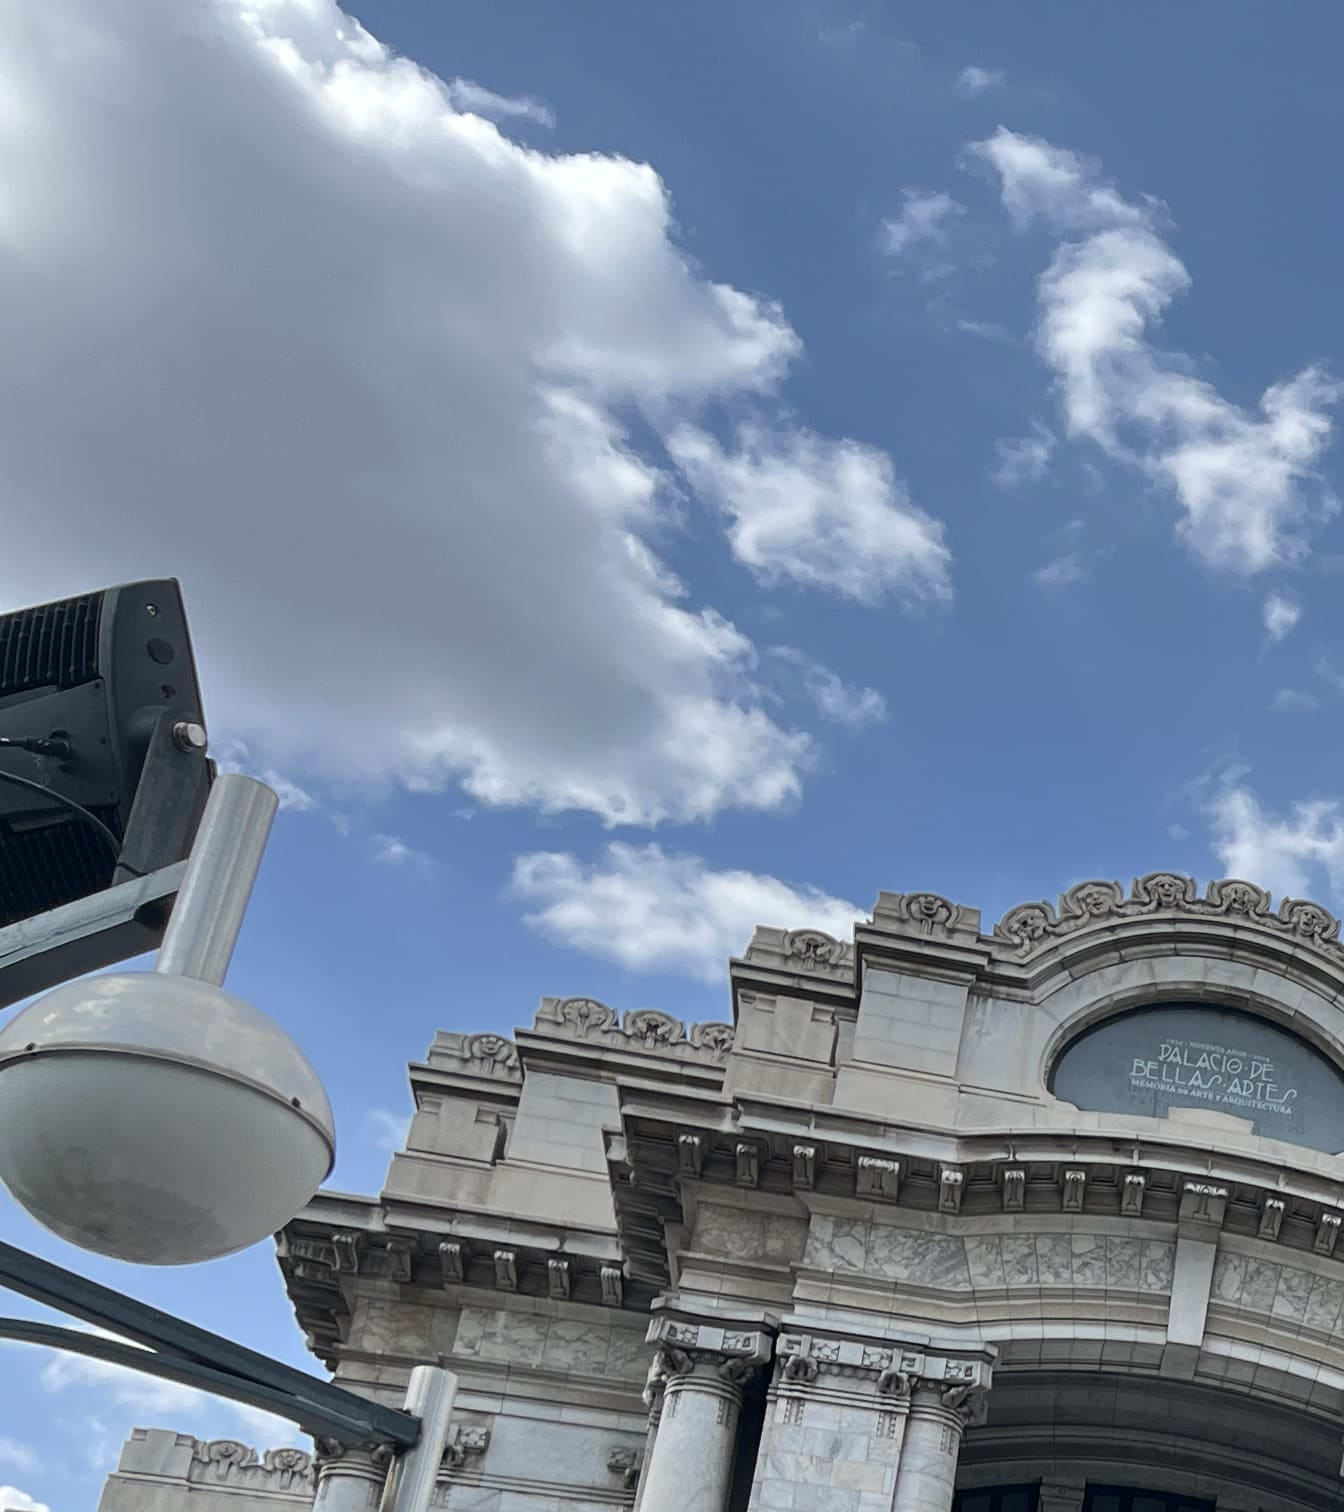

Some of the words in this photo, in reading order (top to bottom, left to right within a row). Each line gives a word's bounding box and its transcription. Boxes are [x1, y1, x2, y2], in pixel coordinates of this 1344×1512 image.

[1129, 1058, 1222, 1089] BELLAS
[1226, 1077, 1298, 1103] ARTES
[1158, 1044, 1243, 1075] PALACIO
[1249, 1061, 1275, 1082] DE
[1131, 1077, 1176, 1093] MEMORIA
[1190, 1089, 1214, 1101] ARTE
[1222, 1095, 1293, 1115] ARQUITECTURA
